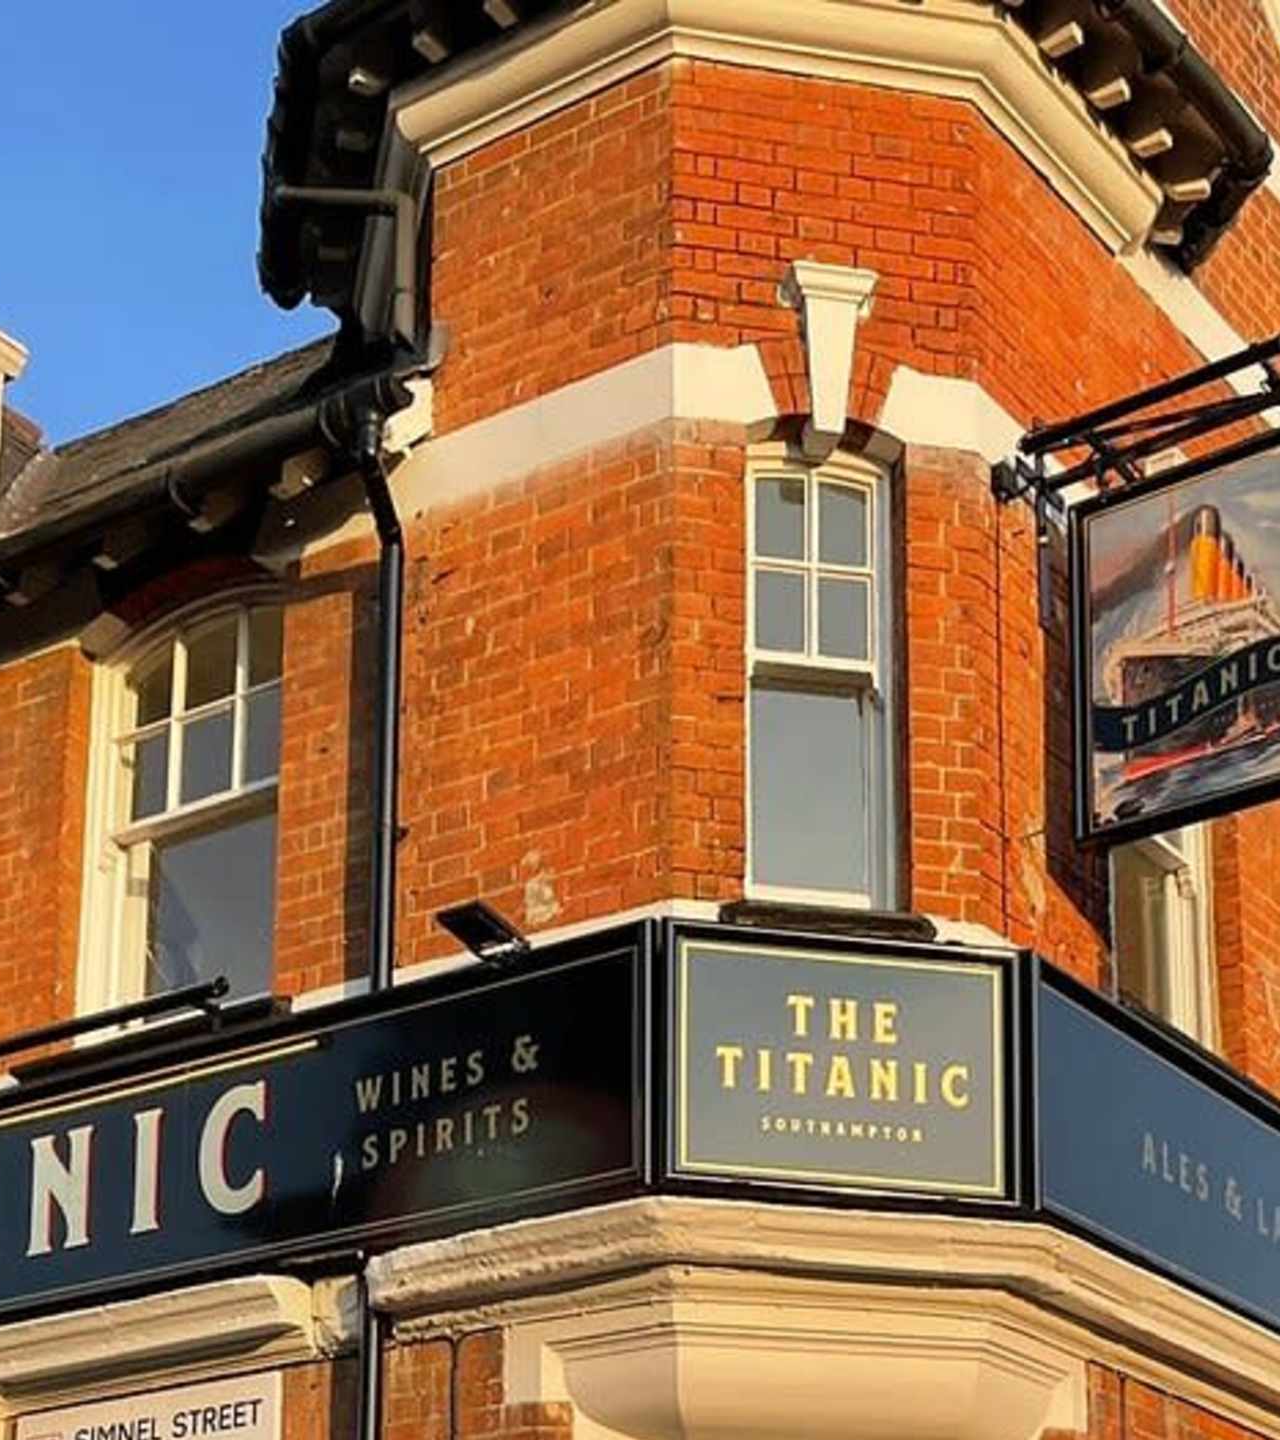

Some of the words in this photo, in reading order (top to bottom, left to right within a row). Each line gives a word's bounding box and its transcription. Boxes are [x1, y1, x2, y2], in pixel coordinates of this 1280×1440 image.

[786, 994, 899, 1044] THE
[355, 1050, 485, 1113] WINES
[510, 1034, 541, 1074] &
[716, 1045, 970, 1108] TITANIC
[361, 1098, 530, 1170] SPIRITS
[761, 1116, 924, 1143] SOUTHAMPTON
[1141, 1131, 1209, 1201] ALES
[1224, 1176, 1243, 1222] &
[172, 1398, 264, 1440] STREET
